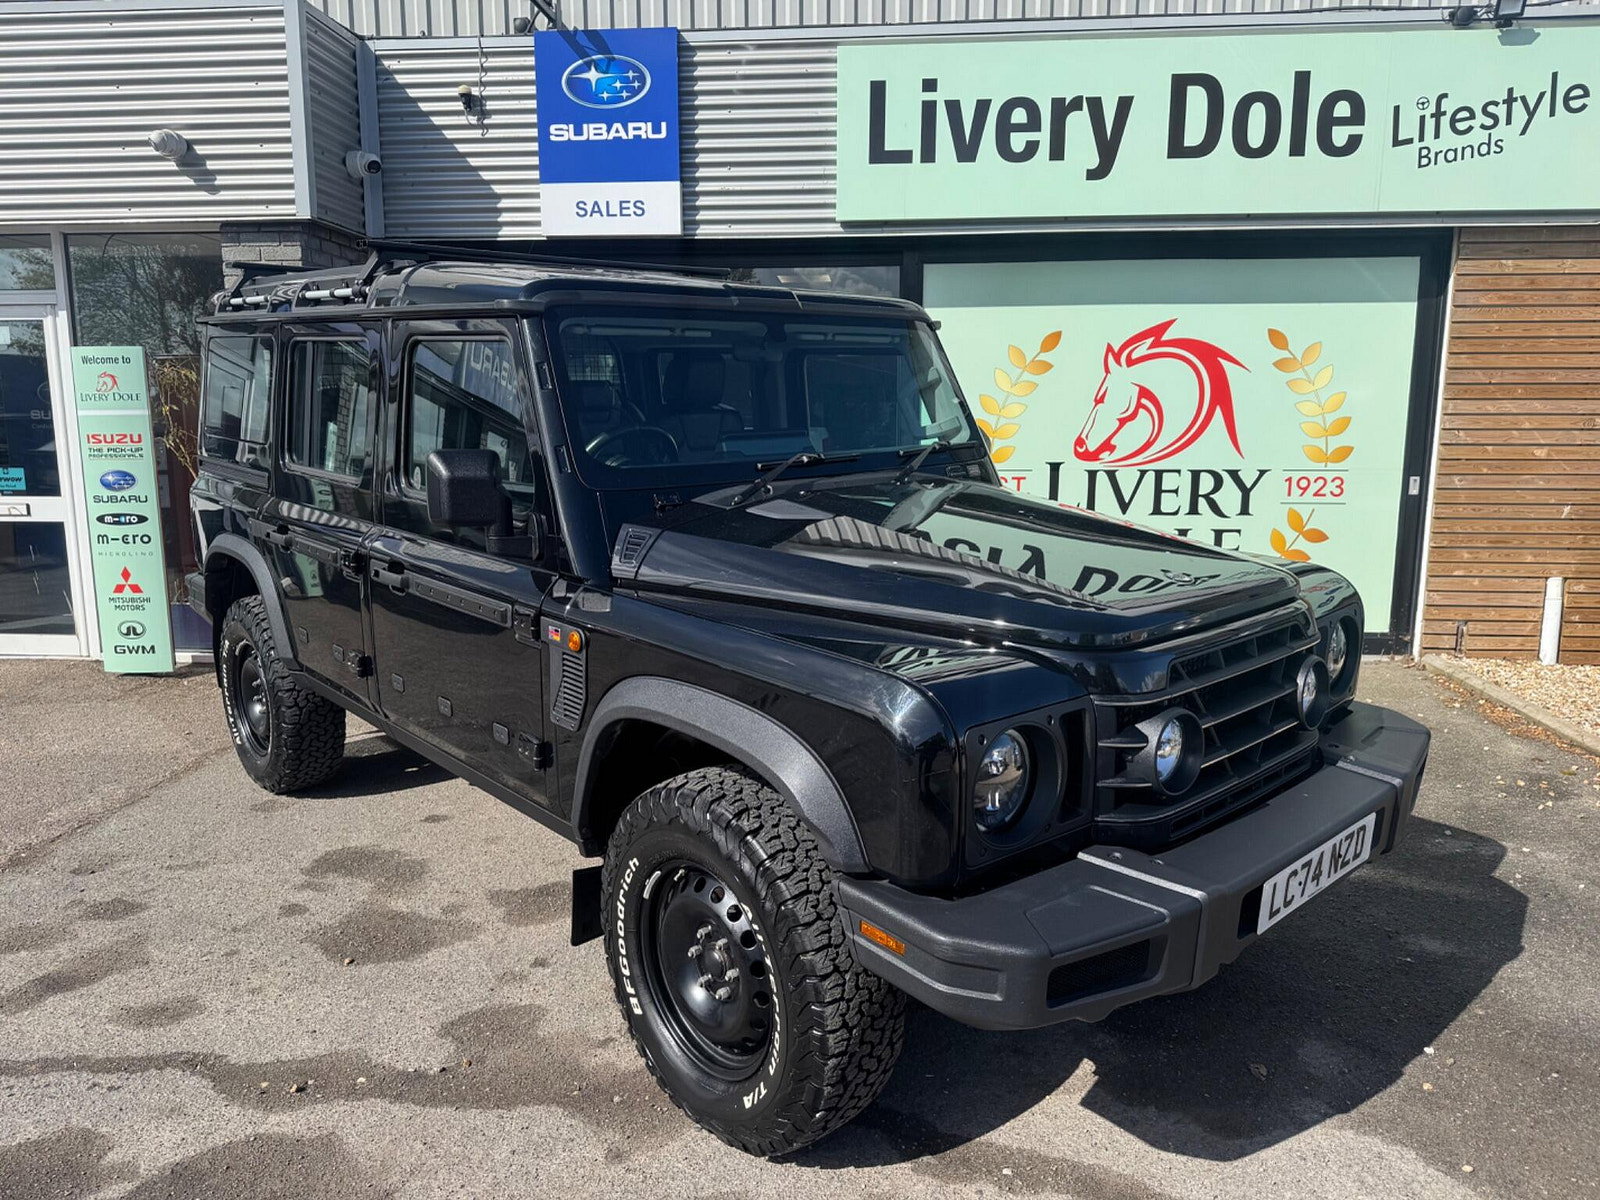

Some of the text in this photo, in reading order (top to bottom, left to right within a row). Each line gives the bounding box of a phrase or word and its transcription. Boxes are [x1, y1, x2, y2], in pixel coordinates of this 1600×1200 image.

[1391, 71, 1591, 148] Lifestyle
[549, 121, 667, 142] SUBARU
[868, 70, 1366, 181] Livery Dole
[1416, 133, 1504, 169] Brands
[575, 200, 646, 218] SALES
[81, 355, 131, 365] Welcome to
[86, 433, 143, 445] ISUZU
[1044, 461, 1272, 519] LIVERY
[1283, 475, 1345, 498] 1923
[93, 494, 148, 504] SUBARU
[108, 596, 151, 604] MITSUBISHI
[114, 645, 156, 655] GWM
[1268, 824, 1367, 921] LC74 NZD
[616, 857, 643, 1016] BFGoodrich
